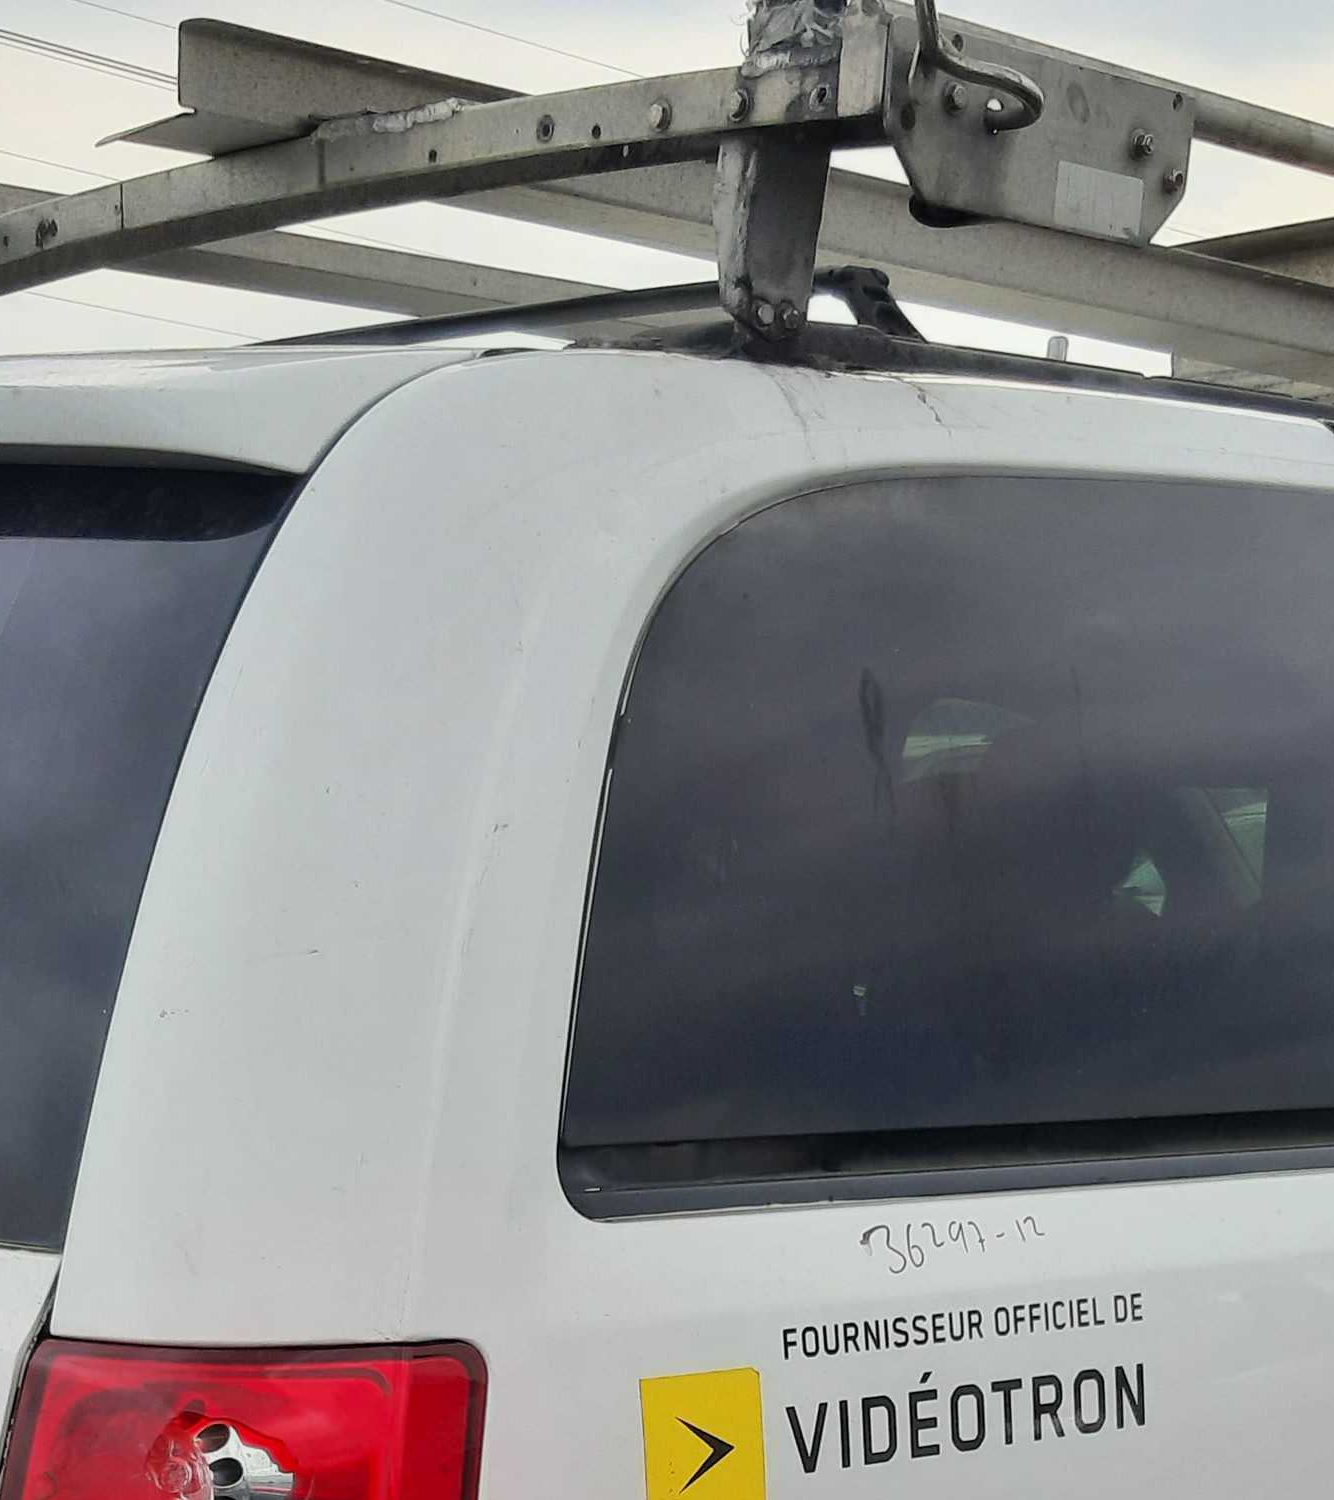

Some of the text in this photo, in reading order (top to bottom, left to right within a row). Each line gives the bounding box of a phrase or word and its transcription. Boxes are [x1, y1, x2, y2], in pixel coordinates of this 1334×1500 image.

[859, 1215, 1047, 1275] 36297-12
[782, 1291, 1145, 1360] FOURNISSEUR OFFICIEL DE
[785, 1363, 1147, 1474] VIDÉOTRON
